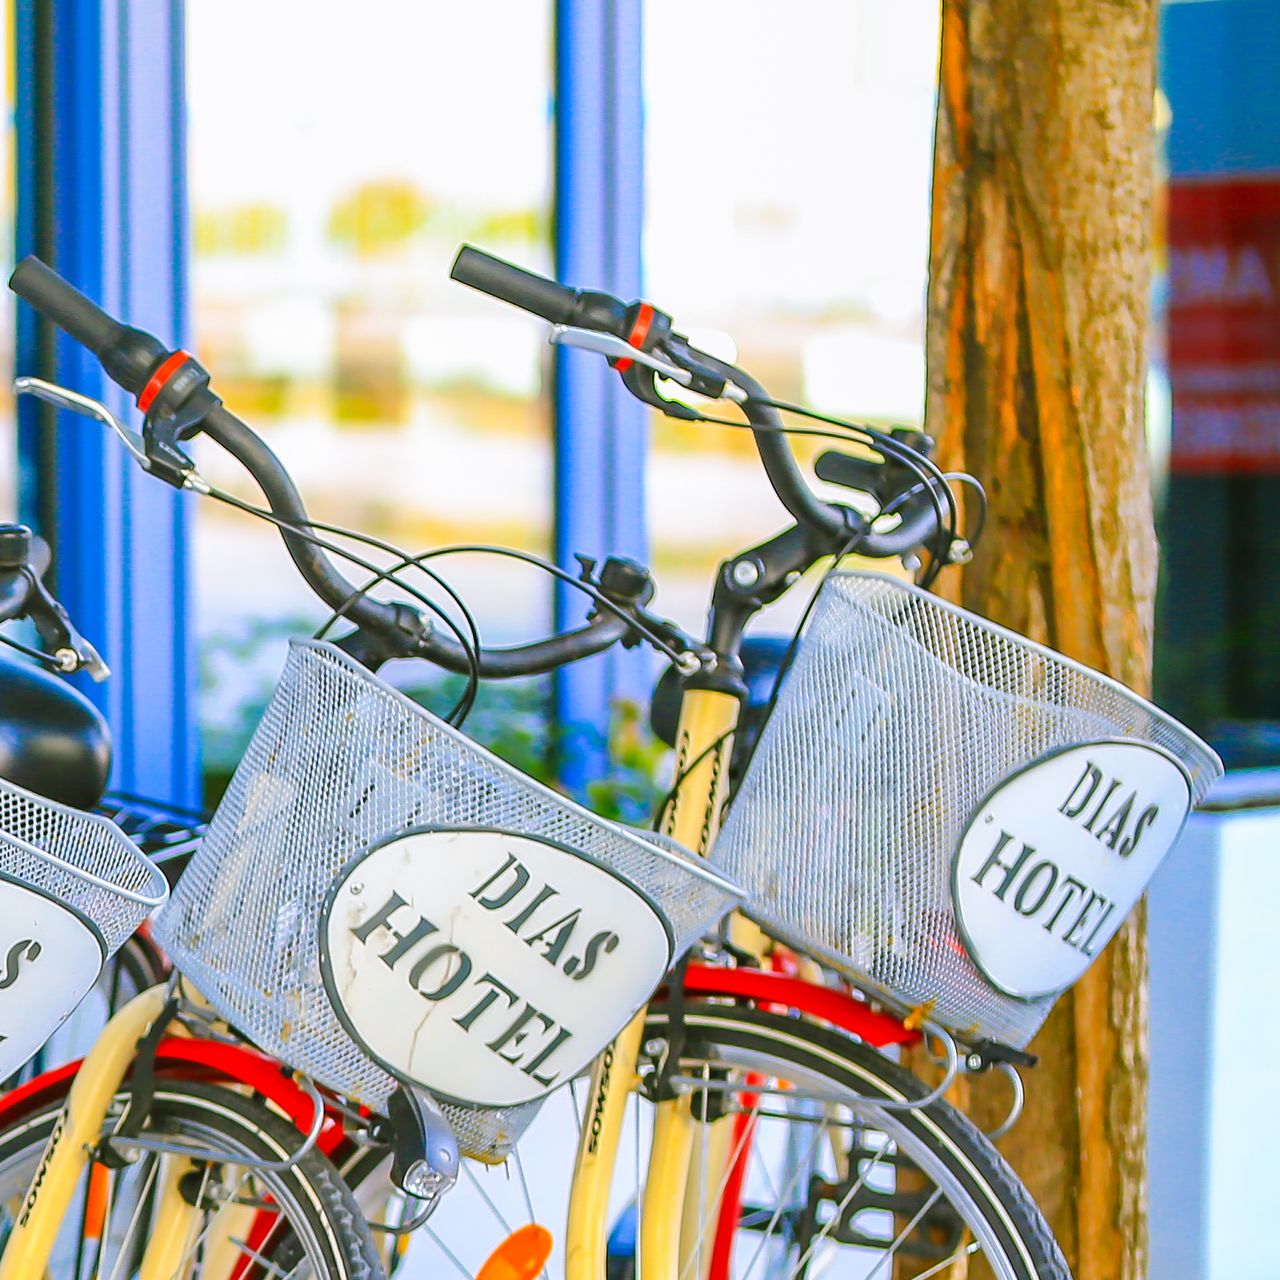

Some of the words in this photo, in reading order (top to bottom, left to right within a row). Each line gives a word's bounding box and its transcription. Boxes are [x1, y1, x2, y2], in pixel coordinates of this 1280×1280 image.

[1058, 760, 1159, 858] DIAS
[468, 852, 620, 981] DIAS
[971, 829, 1116, 956] HOTEL
[350, 889, 574, 1088] HOTEL
